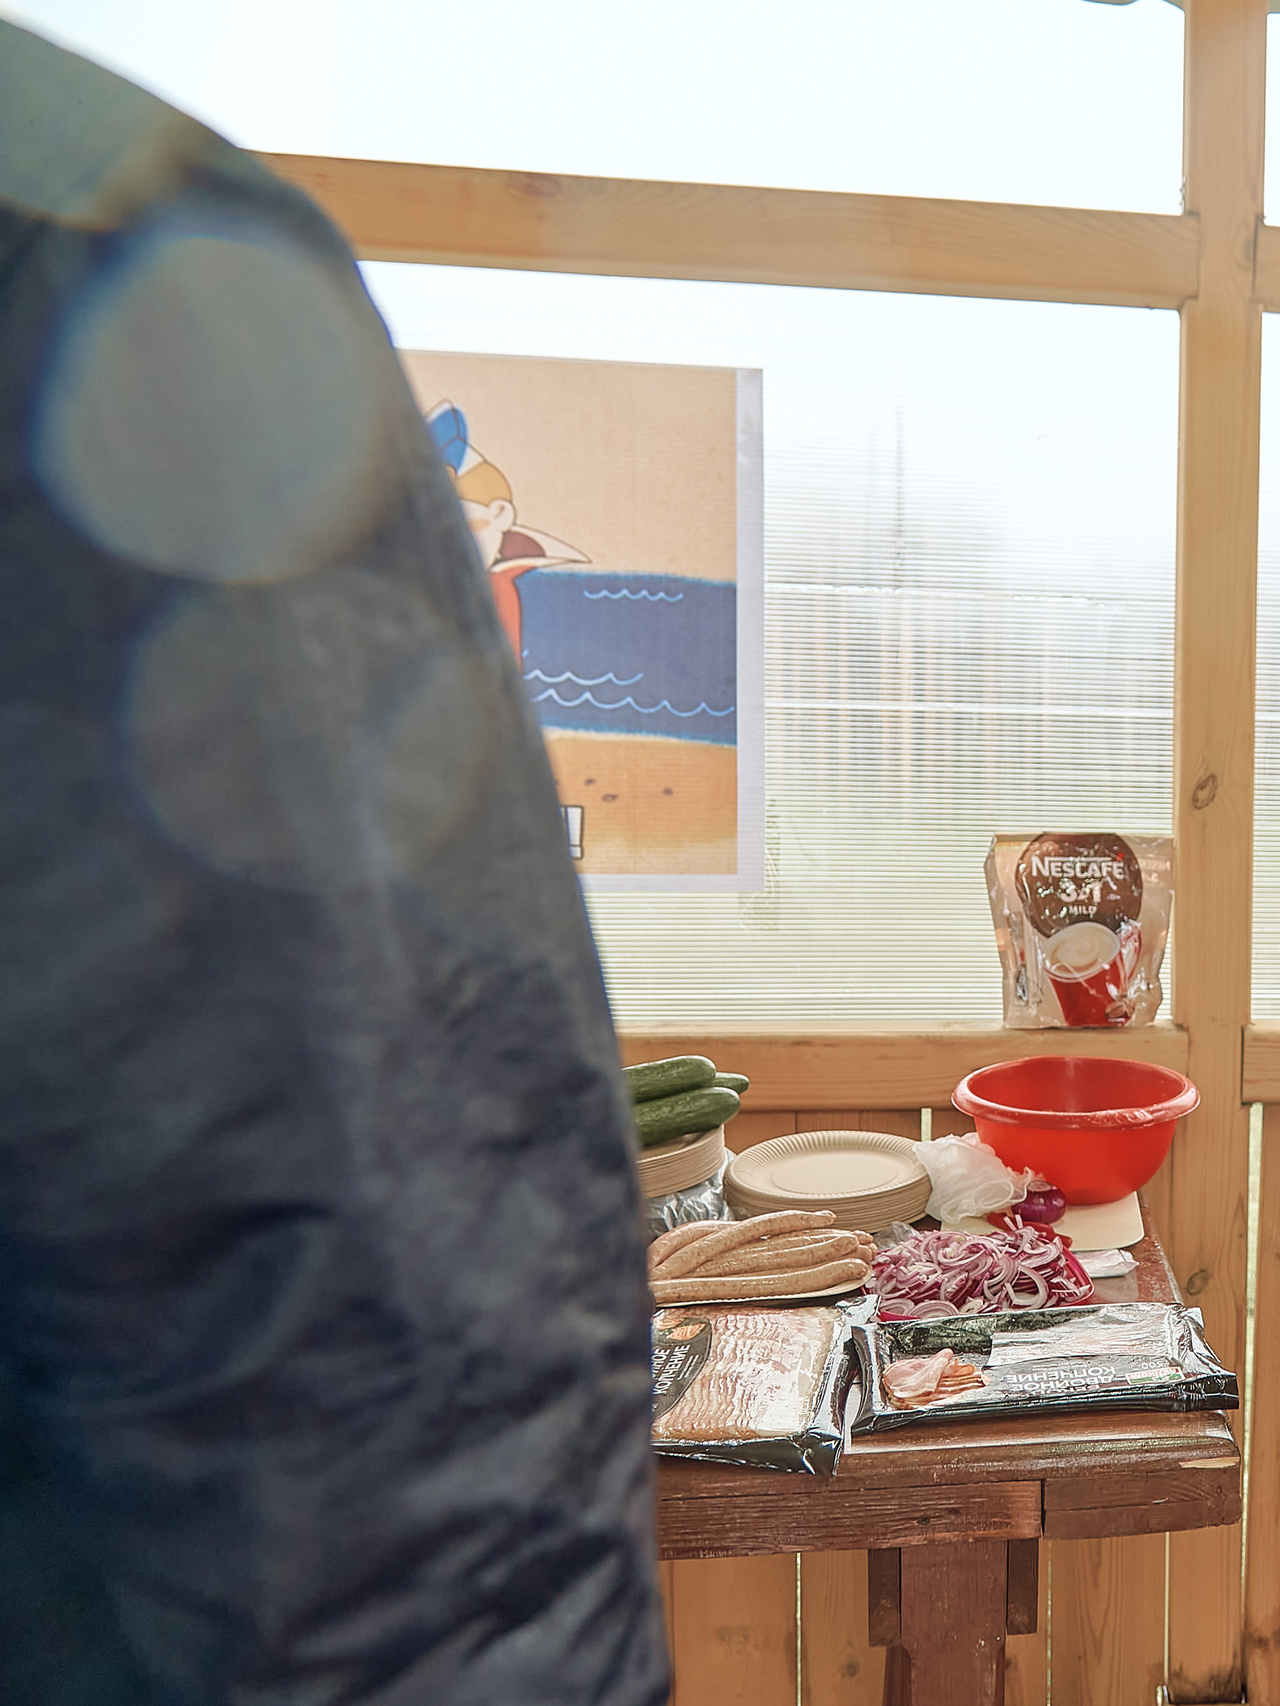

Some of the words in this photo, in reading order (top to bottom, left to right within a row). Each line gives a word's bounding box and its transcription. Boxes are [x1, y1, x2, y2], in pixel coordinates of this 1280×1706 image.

[652, 1344, 691, 1395] КОПЧЕНИЕ
[1005, 1366, 1116, 1383] КОПЧЕНИЕ
[1010, 1374, 1113, 1392] ДВОЙНОЕ
